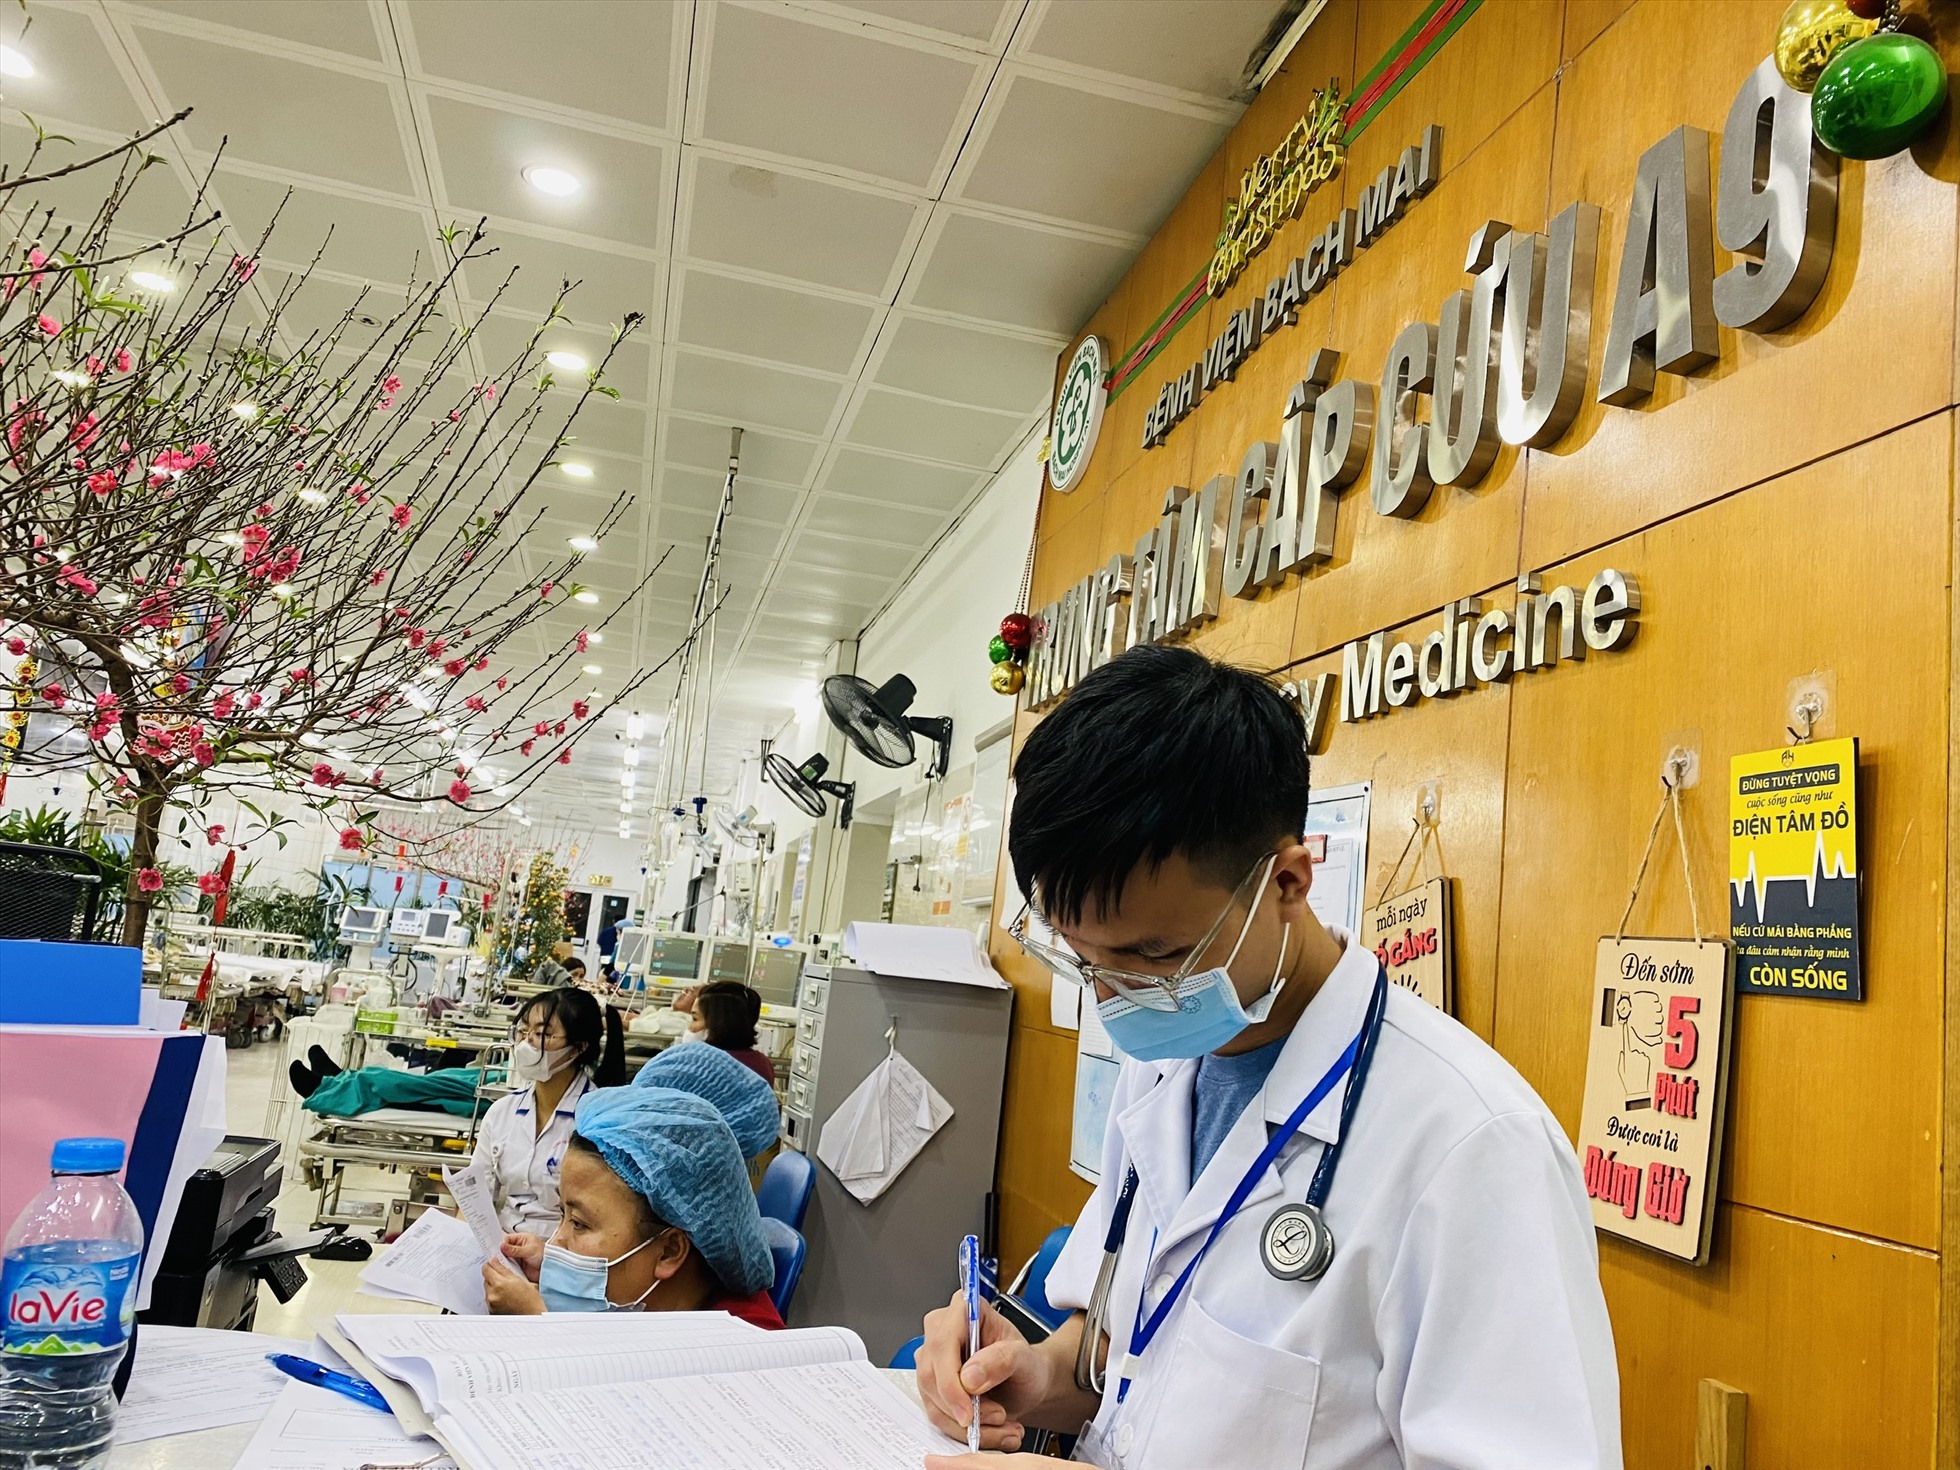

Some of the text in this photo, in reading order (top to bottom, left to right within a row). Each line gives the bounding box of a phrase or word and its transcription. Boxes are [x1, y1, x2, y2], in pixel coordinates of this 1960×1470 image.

[1142, 124, 1443, 449] BỆNH VIỆN BẠCH MAI
[1127, 474, 1233, 651] TÂM
[1223, 348, 1371, 598] CẤP
[1371, 202, 1599, 517] CỨU
[1340, 568, 1640, 722] Medicine
[1742, 769, 1836, 791] ĐỪNG TUYỆT VỌNG
[1746, 790, 1833, 810] cuộc sống cũng như
[1733, 801, 1849, 840] ĐIỆN TÂM ĐỒ
[1376, 898, 1428, 932] mỗi ngày
[1732, 923, 1751, 937] NẾU
[1752, 925, 1765, 937] CỨ
[1786, 923, 1814, 938] BẰNG
[1373, 928, 1437, 969] Ố GẮNG
[1781, 946, 1802, 959] nhận
[1804, 944, 1824, 960] rằng
[1826, 947, 1850, 958] mình
[1620, 952, 1694, 985] Đến sớm
[1750, 961, 1848, 991] CÒN SỐNG
[1664, 996, 1701, 1070] 5
[1653, 1072, 1699, 1120] Phút
[1606, 1116, 1679, 1152] Được coi là
[1584, 1145, 1691, 1226] Đúng Giờ
[9, 1290, 106, 1324] laVie
